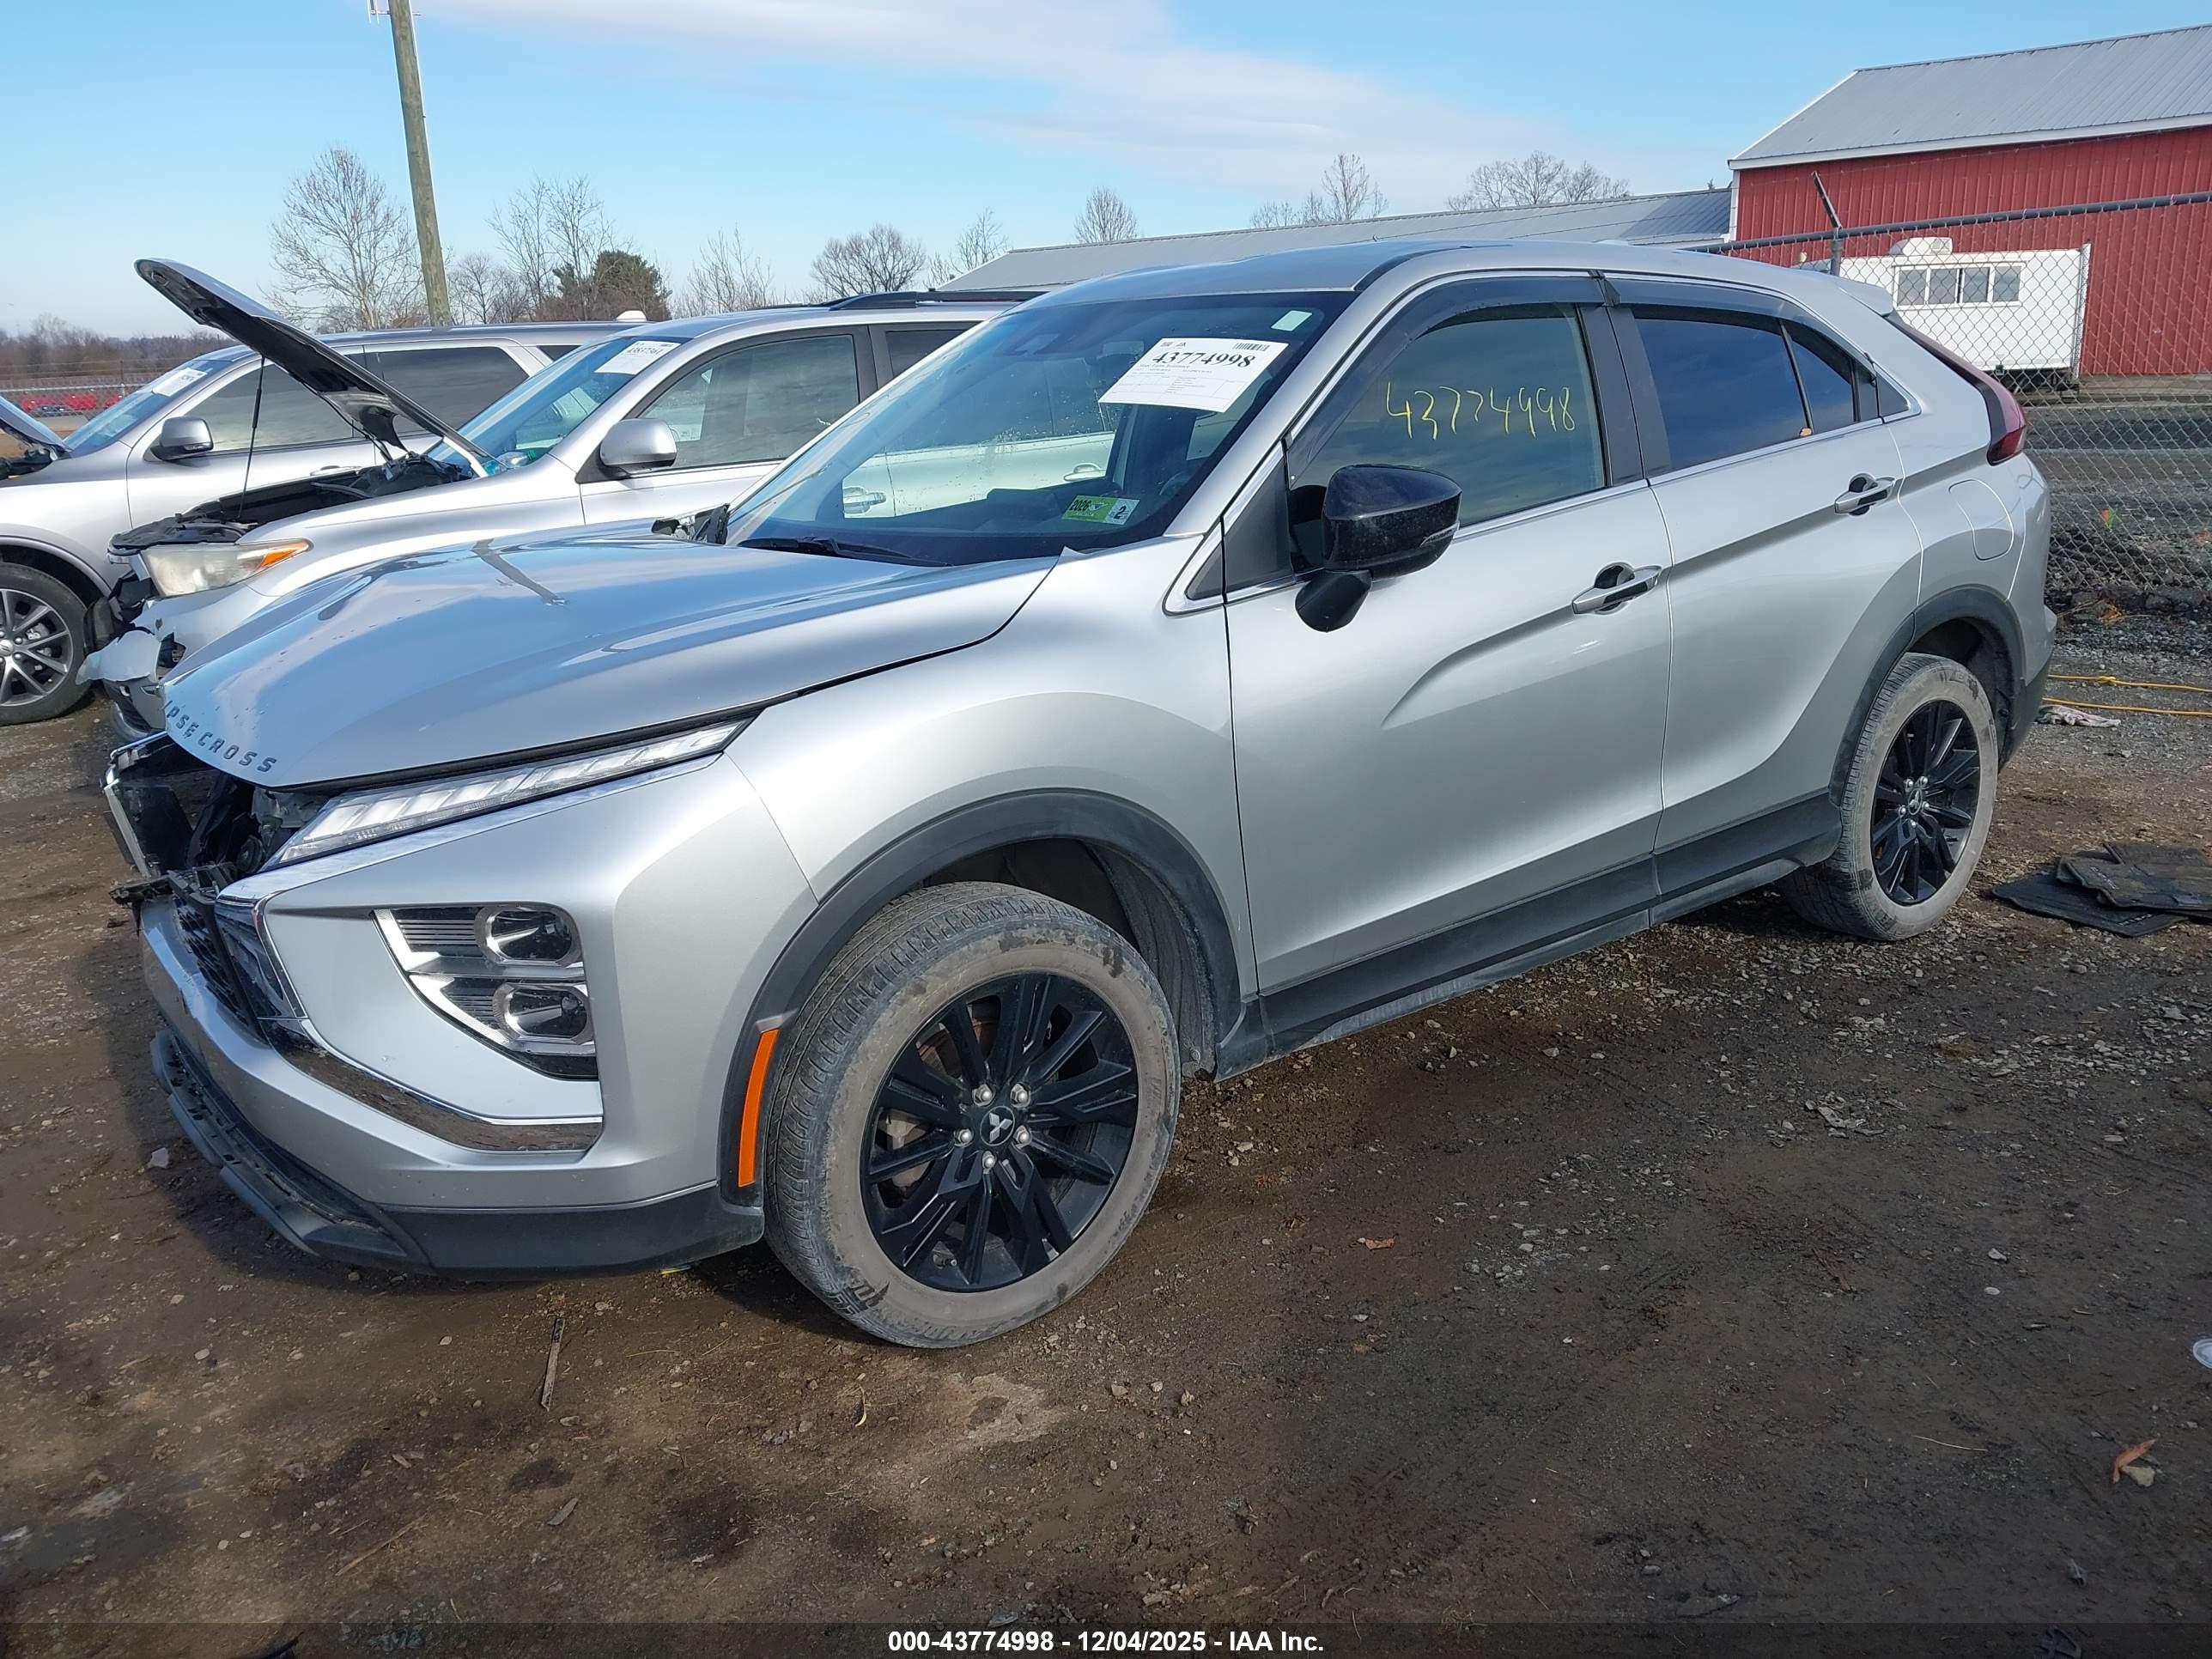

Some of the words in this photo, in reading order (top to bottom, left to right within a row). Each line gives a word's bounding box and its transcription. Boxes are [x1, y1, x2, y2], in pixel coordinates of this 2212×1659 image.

[1152, 350, 1257, 368] 43774998
[1385, 381, 1576, 440] 43774998
[1069, 500, 1091, 511] 2026
[1114, 505, 1127, 519] 2
[198, 732, 277, 773] CROSS
